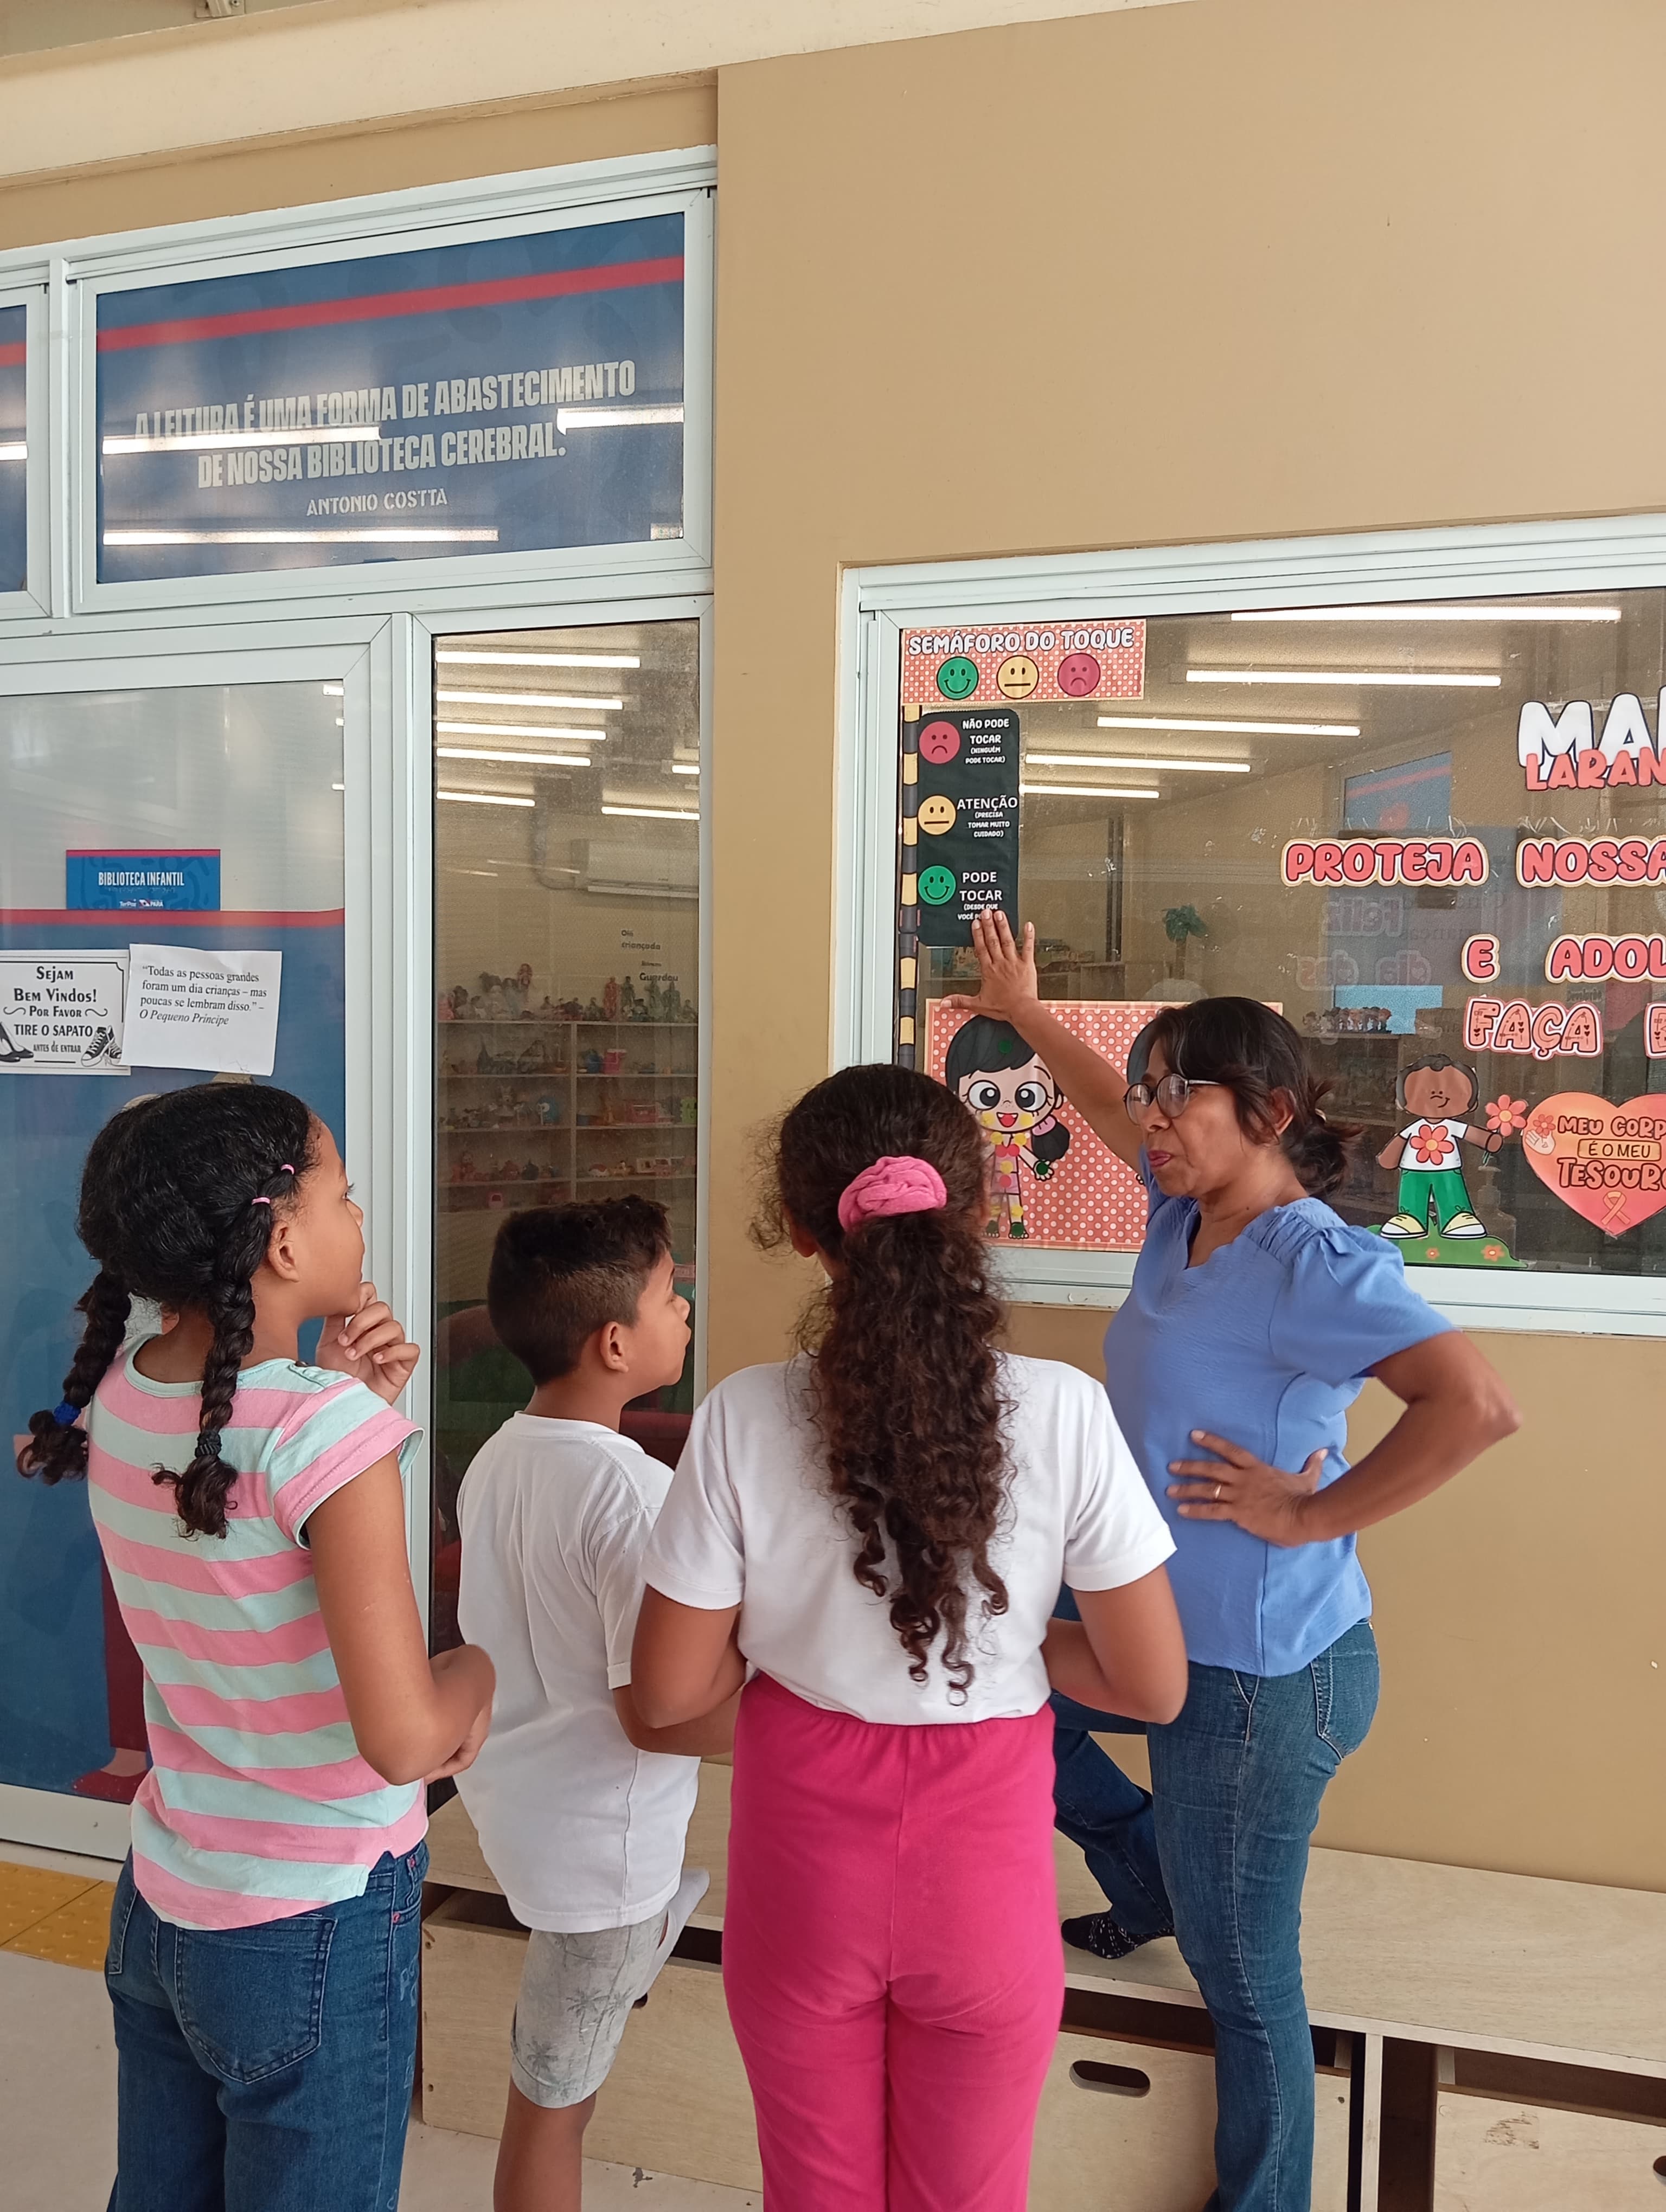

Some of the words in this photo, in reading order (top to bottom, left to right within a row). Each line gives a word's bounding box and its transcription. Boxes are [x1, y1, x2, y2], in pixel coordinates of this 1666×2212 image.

[135, 412, 149, 439] A
[244, 394, 255, 432] É
[259, 395, 312, 431] UMA
[316, 386, 397, 427] FORMA
[402, 382, 428, 419] DE
[433, 359, 636, 416] ABASTECIMENTO
[197, 453, 223, 488] DE
[227, 446, 303, 486] NOSSA
[307, 433, 436, 479] BIBLIOTECA
[440, 421, 567, 467] CEREBRAL.
[306, 493, 378, 517] ANTONIO
[383, 488, 448, 510] COSTTA
[908, 631, 1021, 656] SEMÁFORO
[1025, 630, 1055, 651] DO
[1060, 627, 1135, 651] TOQUE
[962, 718, 983, 730] NÃO
[984, 718, 1010, 729] PODE
[1518, 684, 1666, 770] MA
[969, 734, 1002, 744] TOCAR
[970, 745, 1001, 755] (NINGUÉM
[957, 795, 1018, 811] ATENÇÃO
[1285, 841, 1484, 882] PROTEJA
[1522, 840, 1666, 882] NOSSA
[99, 872, 145, 885] BIBLIOTECA
[147, 872, 184, 886] INFANTIL
[962, 872, 997, 883] PODE
[959, 890, 1002, 901] TOCAR
[957, 912, 974, 920] VOCÊ
[1466, 938, 1495, 978] E
[1550, 938, 1666, 978] ADOL
[189, 971, 225, 981] pessoas
[227, 972, 259, 983] grandes
[142, 980, 169, 991] foram
[171, 985, 186, 993] um
[189, 983, 203, 994] dia
[206, 985, 240, 998] crianças
[140, 996, 172, 1006] poucas
[187, 998, 226, 1010] lembram
[139, 1009, 148, 1019] O
[150, 1009, 190, 1023] Pequeno
[14, 1024, 38, 1036] TIRE
[41, 1025, 49, 1036] O
[53, 1025, 93, 1037] SAPATO
[1468, 999, 1598, 1057] FAÇA
[1558, 1115, 1604, 1135] MEU
[1588, 1141, 1598, 1156] É
[1602, 1143, 1613, 1156] O
[1617, 1144, 1651, 1158] MEU
